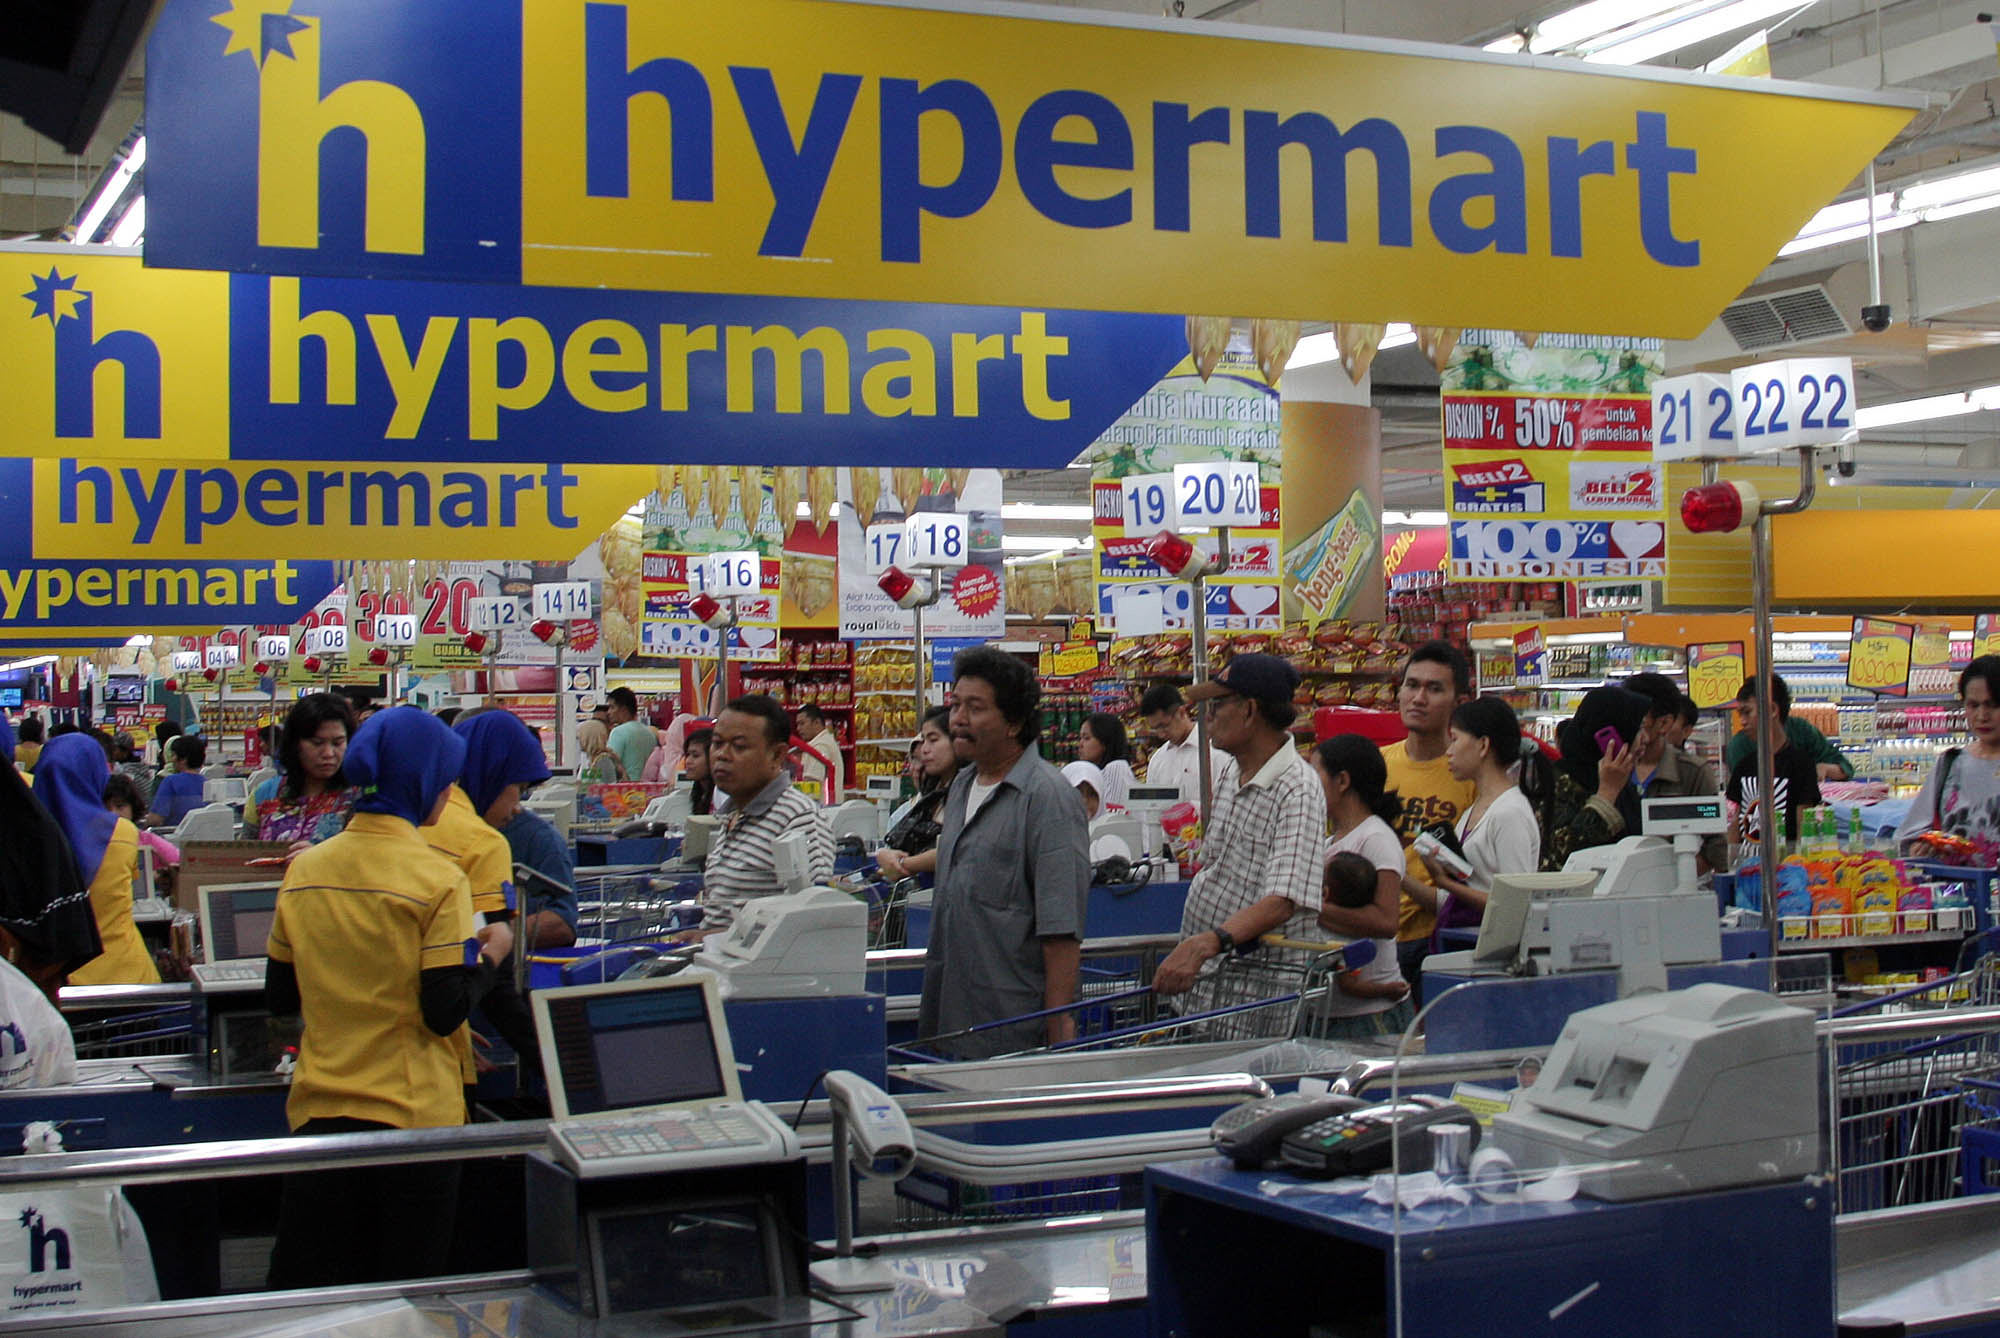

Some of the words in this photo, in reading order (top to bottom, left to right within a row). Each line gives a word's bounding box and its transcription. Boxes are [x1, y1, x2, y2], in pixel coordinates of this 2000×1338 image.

[585, 2, 1700, 268] hypermart
[269, 276, 1071, 440] hypermart
[1184, 390, 1280, 422] Muraaah
[1605, 408, 1636, 423] untuk
[1708, 387, 1733, 440] 2
[1742, 379, 1789, 437] 22
[1798, 374, 1850, 429] 22
[1445, 404, 1484, 441] DISKON
[1660, 389, 1691, 445] 21
[1146, 423, 1179, 447] Hari
[1180, 426, 1225, 447] Penuh
[1227, 428, 1279, 449] Berkah
[1581, 425, 1639, 444] pembelian
[1461, 470, 1505, 486] BELI
[1502, 463, 1528, 482] 2
[1586, 481, 1625, 496] BELI
[1627, 470, 1655, 497] 2
[59, 458, 579, 545] hypermart
[1095, 489, 1124, 519] DISKO
[1128, 484, 1165, 526] 19
[1182, 473, 1225, 515] 20
[1233, 473, 1257, 515] 20
[1454, 501, 1525, 513] GRATIS
[872, 532, 901, 566] 17
[925, 523, 962, 558] 18
[1455, 519, 1607, 560] 100%
[693, 563, 705, 591] 1
[720, 558, 752, 587] 16
[1293, 518, 1361, 615] beng-beng
[1451, 560, 1665, 578] INDONESIA
[490, 602, 515, 625] 12
[543, 590, 563, 614] 14
[568, 588, 588, 612] 14
[323, 630, 344, 648] 08
[390, 621, 412, 640] 10
[174, 655, 187, 670] 02
[208, 651, 222, 666] 04
[224, 650, 237, 665] 04
[267, 640, 286, 657] 06
[13, 1280, 83, 1299] hypermart
